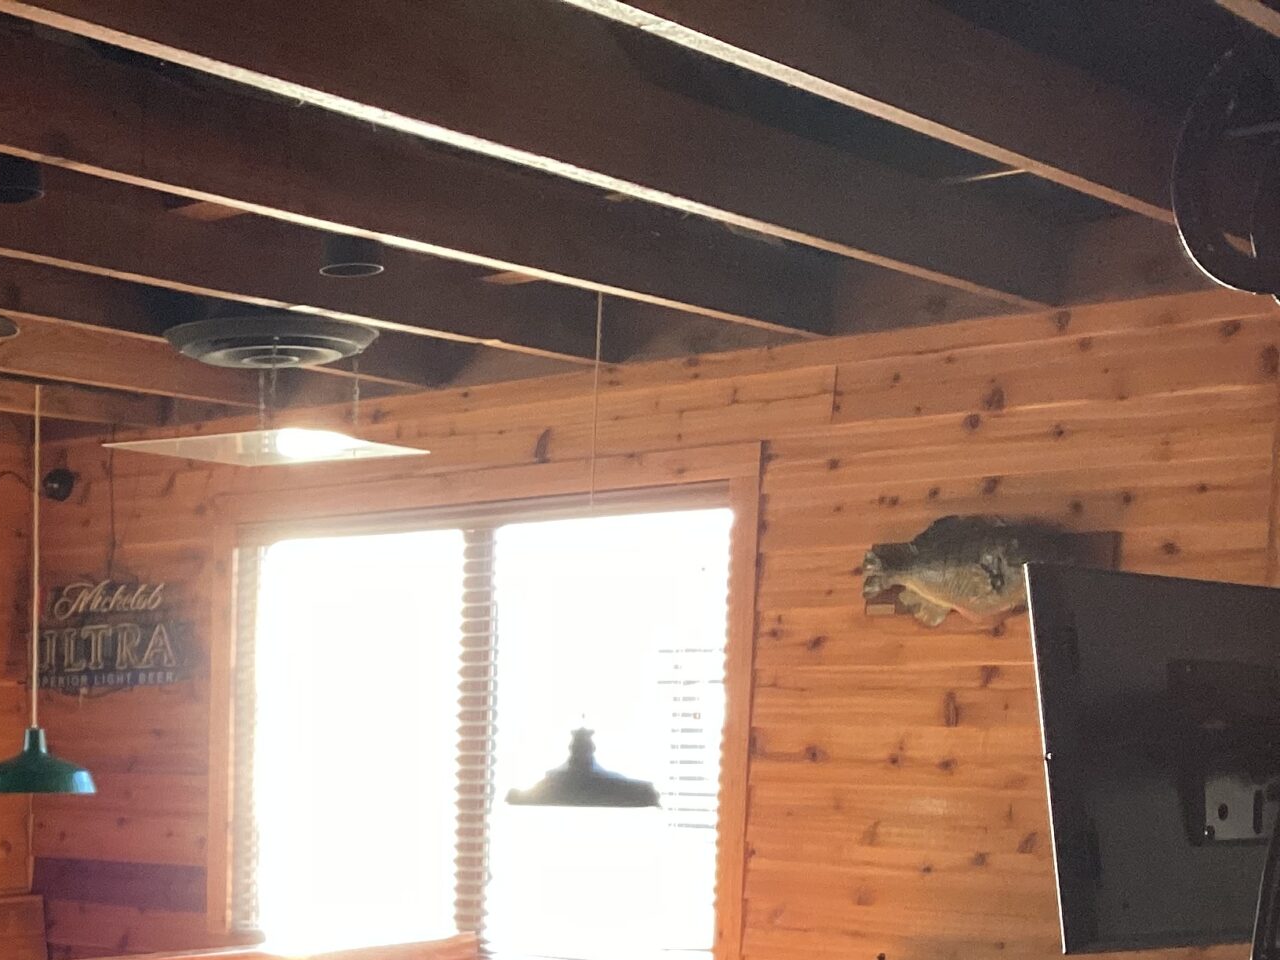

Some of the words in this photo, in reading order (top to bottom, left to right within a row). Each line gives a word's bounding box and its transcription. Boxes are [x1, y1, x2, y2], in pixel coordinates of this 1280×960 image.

[54, 579, 165, 621] Michelob
[28, 674, 88, 688] PERIOR
[94, 672, 131, 686] LIGHT
